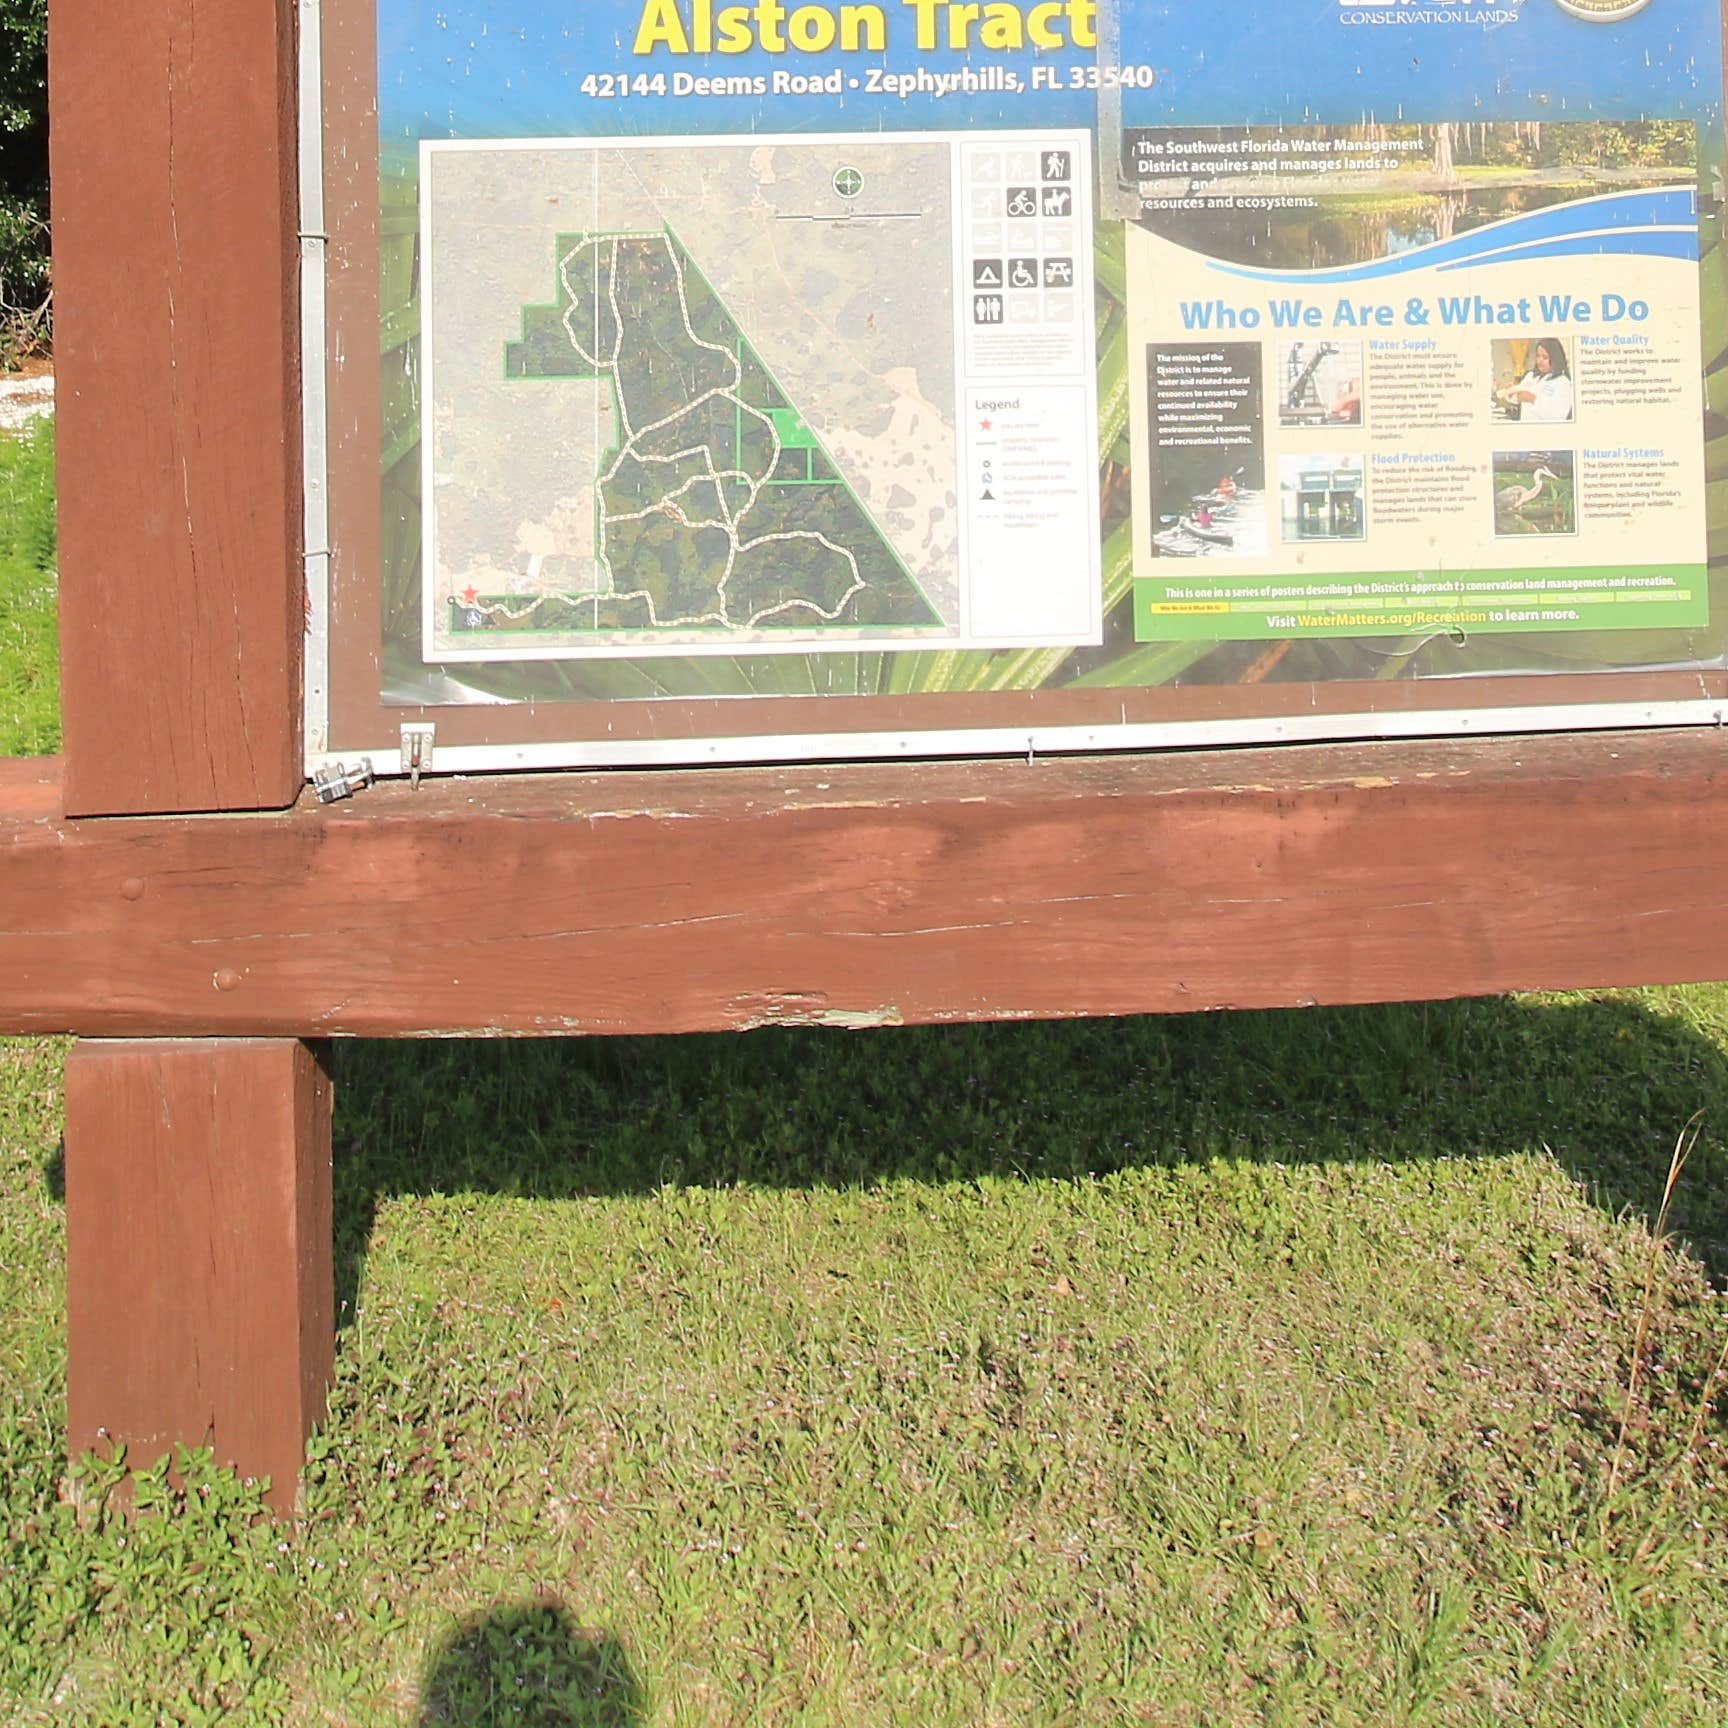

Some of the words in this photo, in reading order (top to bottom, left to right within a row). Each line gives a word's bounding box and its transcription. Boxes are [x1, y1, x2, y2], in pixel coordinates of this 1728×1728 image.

[1339, 9, 1462, 25] CONSERVATION
[1465, 9, 1518, 23] LANDS
[579, 73, 666, 97] 42144
[673, 71, 766, 96] Deems
[773, 69, 844, 94] Road
[865, 66, 1024, 99] Zephyrhills,
[1031, 68, 1063, 90] FL
[1068, 66, 1153, 90] 33540
[1138, 141, 1162, 156] The
[1166, 139, 1238, 155] Southwest
[1240, 138, 1288, 154] Florida
[1290, 138, 1331, 153] Water
[1334, 137, 1423, 154] Management
[1138, 158, 1188, 173] District
[1190, 158, 1248, 175] acquires
[1251, 157, 1278, 171] and
[1279, 158, 1342, 174] manages
[1344, 155, 1381, 170] lands
[1383, 156, 1399, 169] to
[1139, 197, 1206, 210] resources
[1207, 195, 1233, 209] and
[1236, 194, 1318, 212] ecosystems.
[1178, 300, 1260, 331] Who
[1267, 299, 1323, 329] We
[1332, 298, 1394, 328] Are
[1403, 296, 1430, 326] &
[1437, 294, 1531, 326] What
[1538, 294, 1592, 323] We
[1601, 293, 1649, 322] Do
[1369, 339, 1399, 350] Water
[1402, 338, 1436, 351] Supply
[1580, 335, 1610, 346] Water
[1612, 334, 1648, 346] Quality
[974, 398, 1021, 412] Legend
[1371, 453, 1400, 464] Flood
[1402, 451, 1456, 463] Protection
[1583, 448, 1621, 459] Natural
[1623, 447, 1664, 459] Systems
[1165, 587, 1184, 599] This
[1185, 586, 1193, 598] is
[1195, 588, 1211, 598] one
[1214, 585, 1222, 597] in
[1223, 589, 1231, 598] a
[1230, 585, 1258, 598] series
[1260, 585, 1270, 596] of
[1271, 585, 1305, 598] posters
[1305, 583, 1352, 597] describing
[1353, 583, 1370, 594] the
[1410, 580, 1453, 594] approach
[1465, 579, 1524, 591] conservation
[1525, 578, 1545, 590] land
[1546, 577, 1608, 591] management
[1608, 576, 1626, 588] and
[1626, 575, 1676, 587] recreation.
[1265, 614, 1296, 628] Visit
[1297, 608, 1486, 630] WaterMatters.org/Recreation
[1488, 610, 1503, 622] to
[1506, 607, 1540, 621] learn
[1540, 609, 1579, 620] more.
